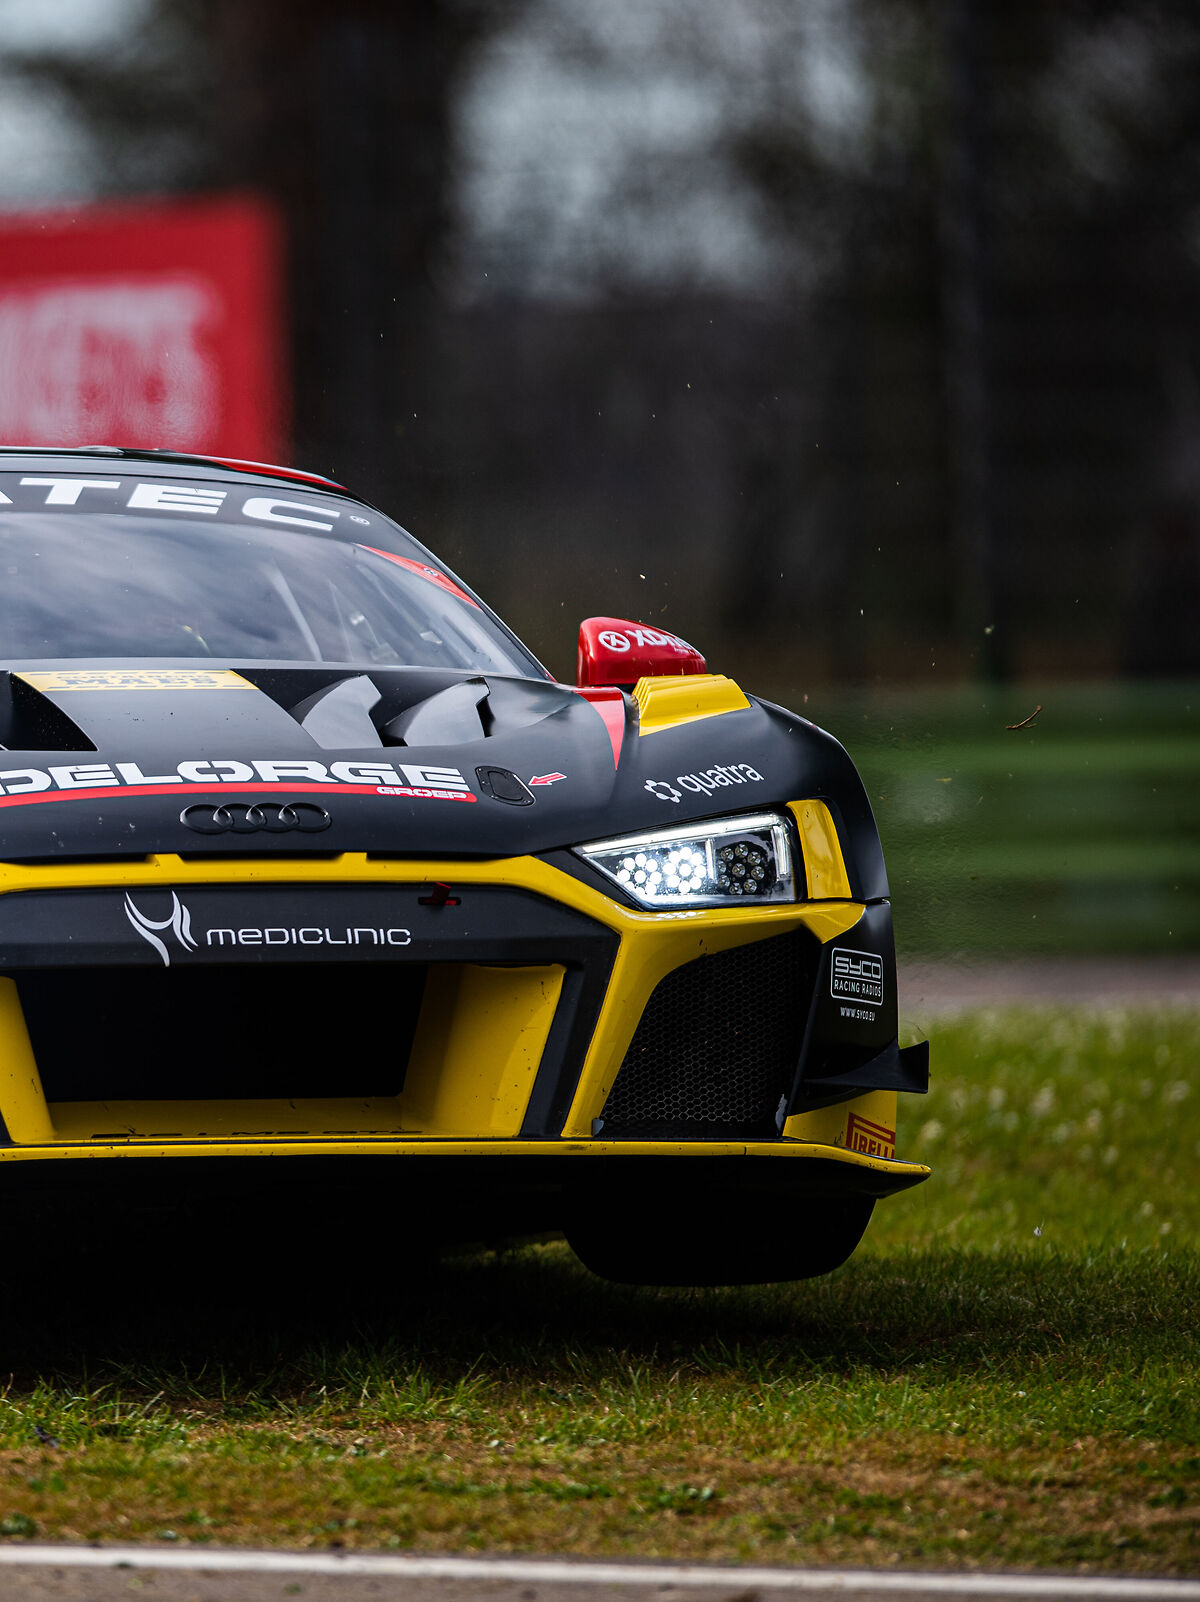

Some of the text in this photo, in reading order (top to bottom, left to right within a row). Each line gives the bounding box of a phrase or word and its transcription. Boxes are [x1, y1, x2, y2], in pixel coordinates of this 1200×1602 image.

[677, 763, 765, 797] quatra
[376, 786, 468, 799] GROEP
[834, 956, 881, 979] SYCO
[833, 979, 881, 997] RACING RADIOS
[840, 1006, 876, 1021] WWW.SYCO.EU
